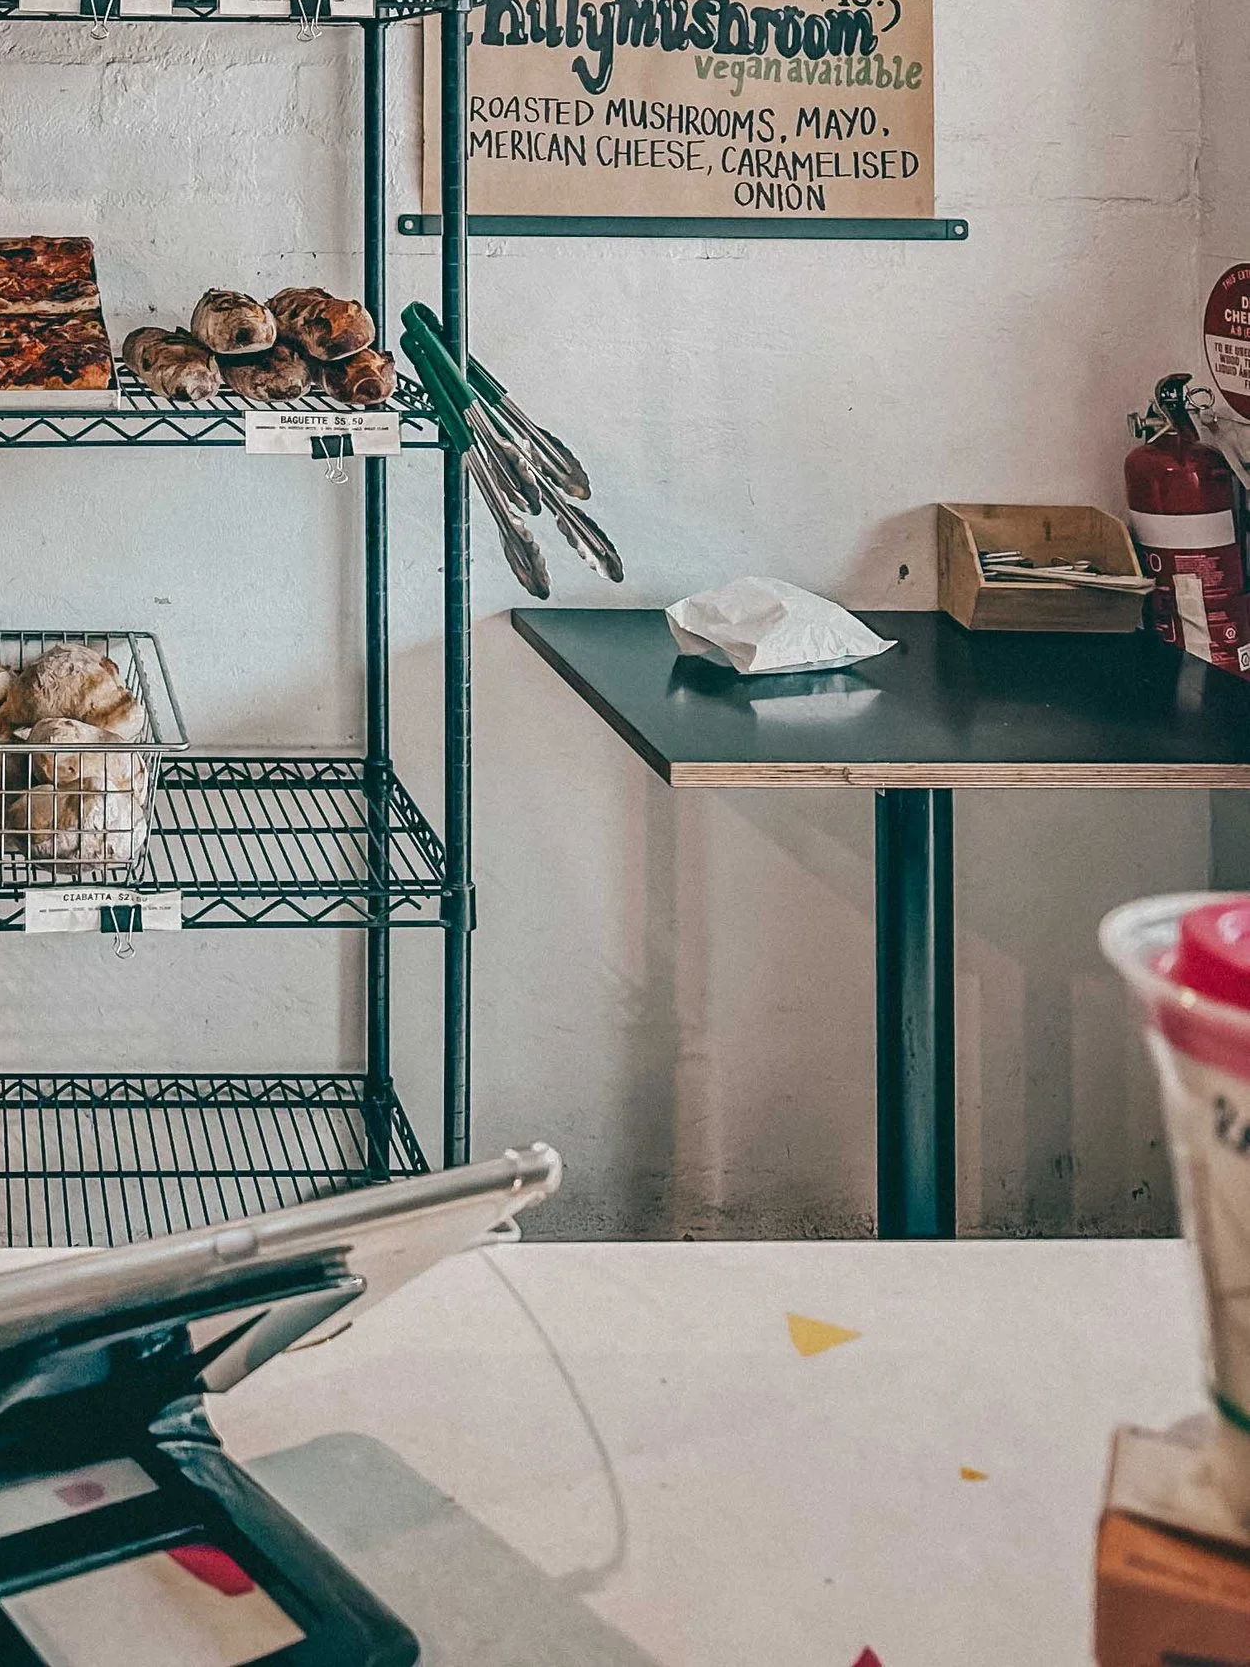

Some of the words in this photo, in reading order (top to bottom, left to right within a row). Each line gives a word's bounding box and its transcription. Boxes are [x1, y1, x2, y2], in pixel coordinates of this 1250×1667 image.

[693, 54, 782, 97] vegan
[786, 53, 923, 90] available
[469, 95, 595, 128] ROASTED
[466, 129, 587, 167] MERICAN
[596, 134, 714, 177] CHEESE,
[720, 145, 920, 182] CARAMELISED
[733, 181, 827, 213] ONION
[280, 415, 328, 425] BAGUETTE
[62, 892, 112, 902] CIABATTA
